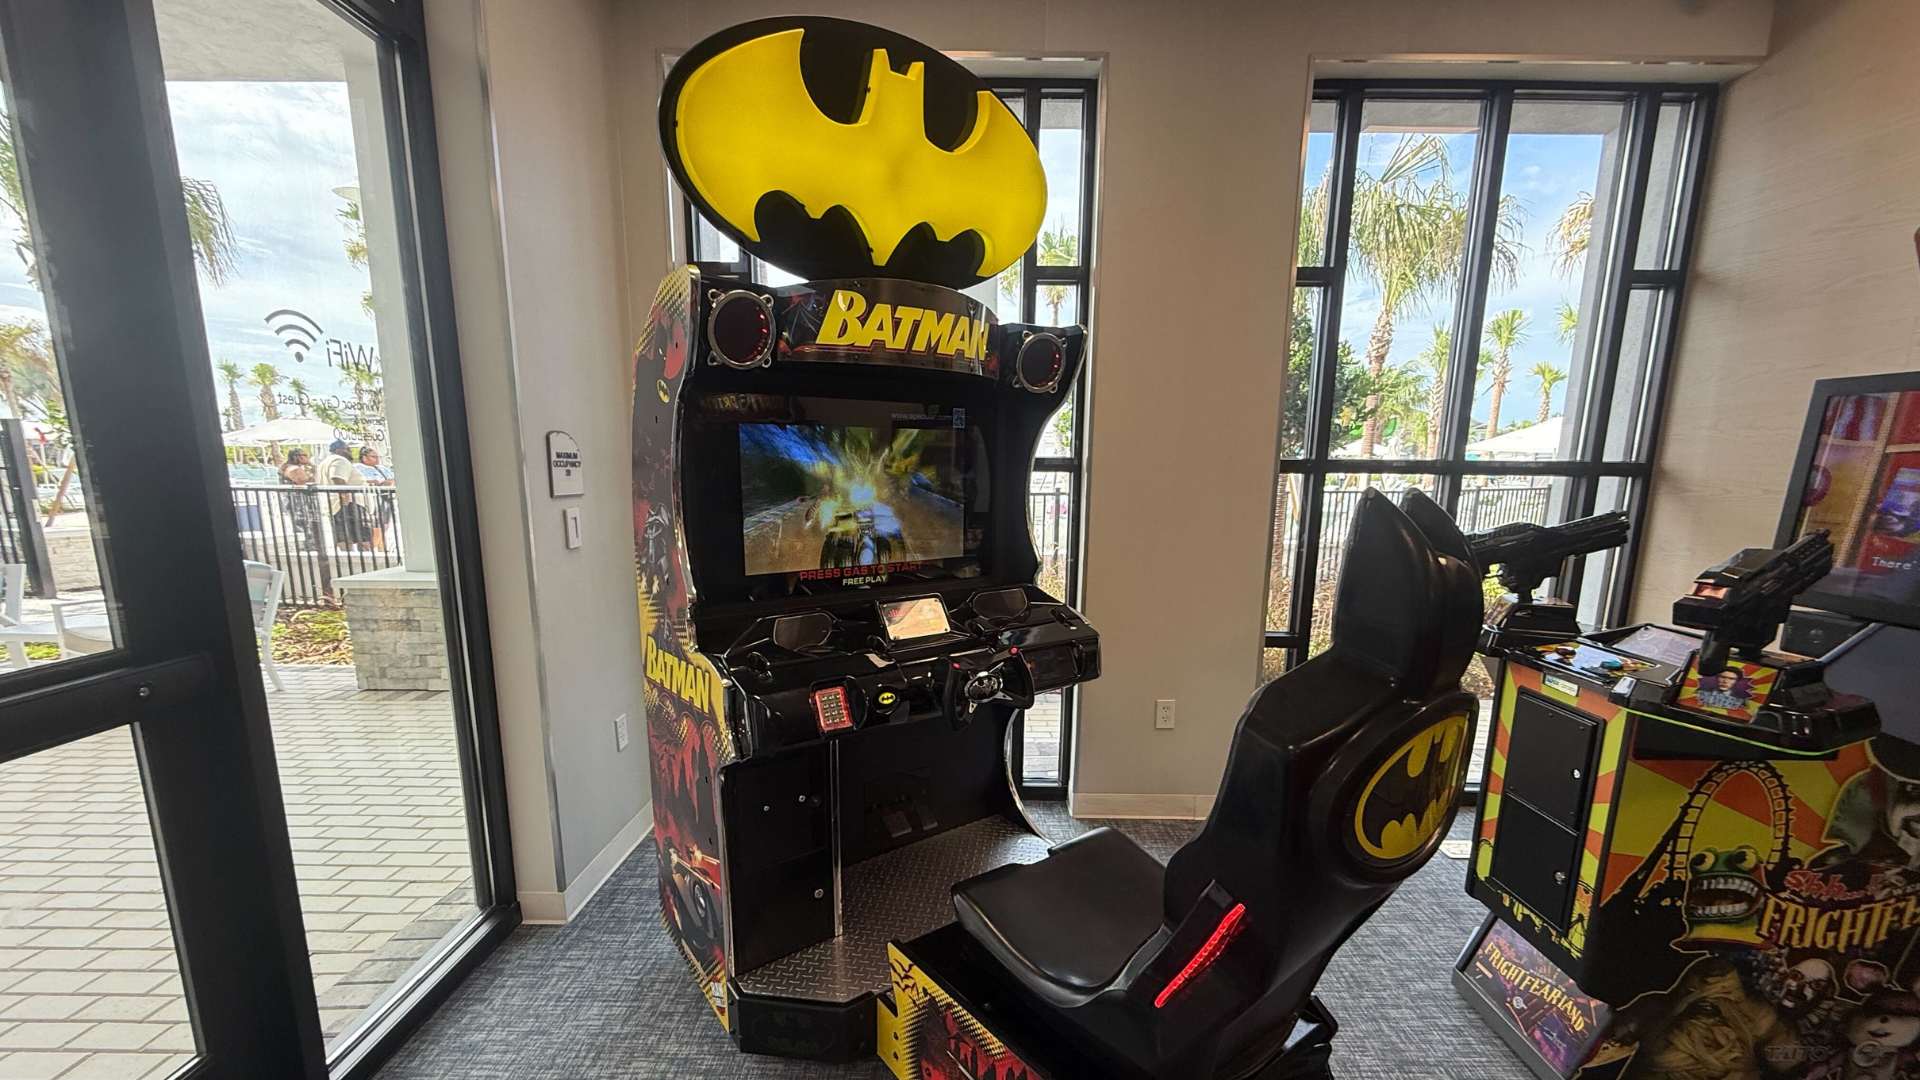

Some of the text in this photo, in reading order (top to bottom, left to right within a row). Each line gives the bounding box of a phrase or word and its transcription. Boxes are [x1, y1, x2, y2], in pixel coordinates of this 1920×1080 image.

[815, 289, 989, 362] BATMAN
[800, 562, 921, 580] PRESS GAS TO START
[842, 575, 887, 586] FREE PLAY
[645, 635, 711, 713] BATMAN
